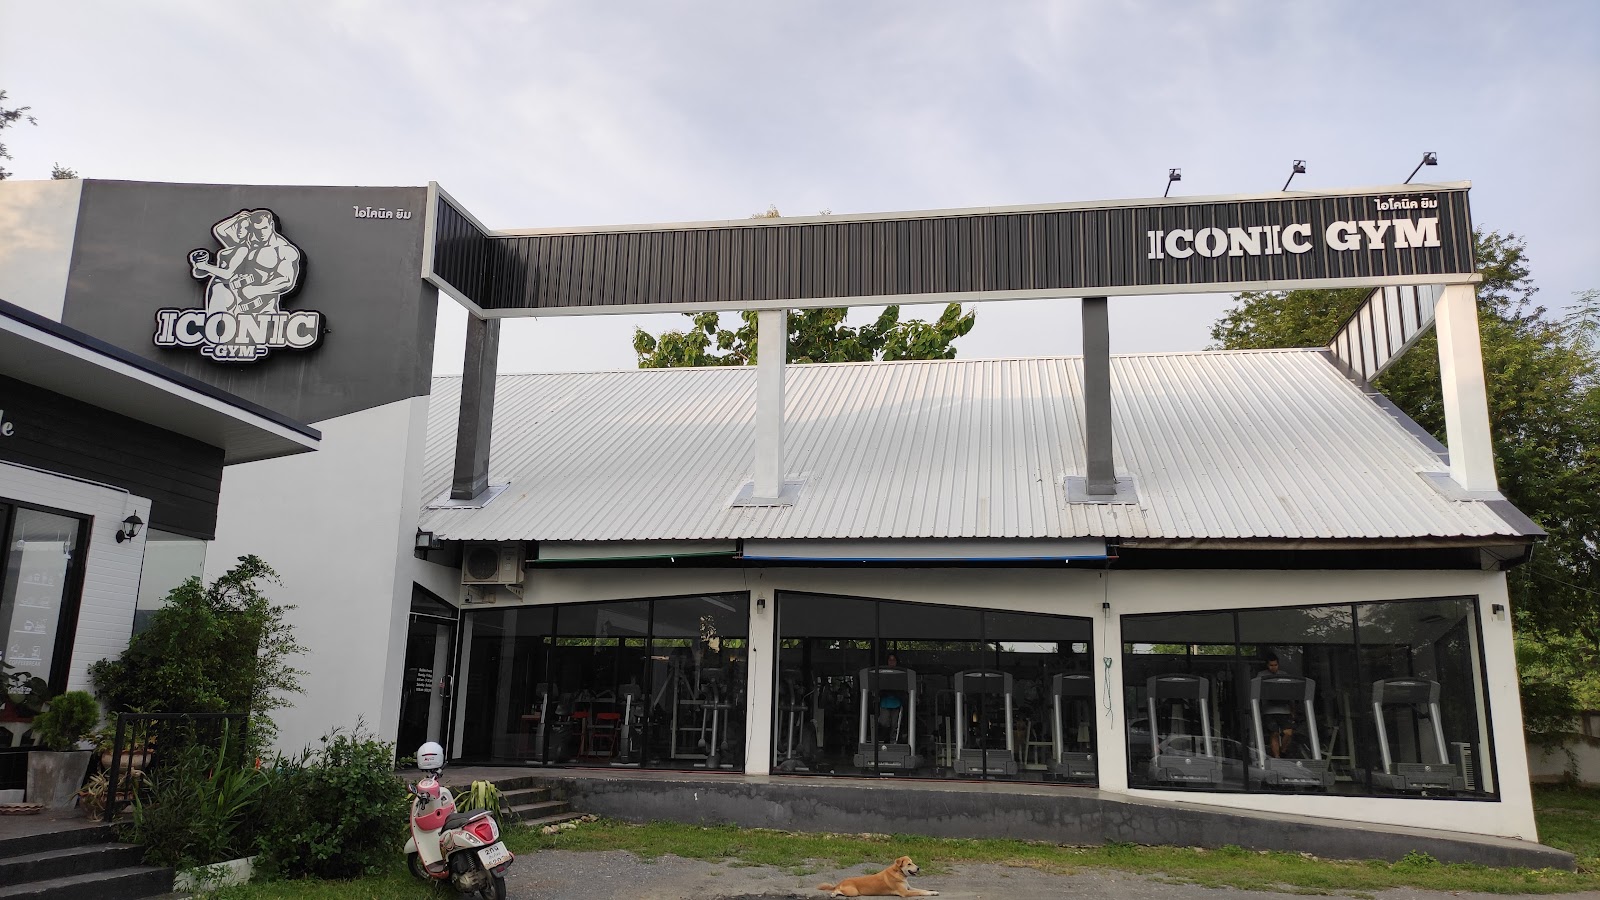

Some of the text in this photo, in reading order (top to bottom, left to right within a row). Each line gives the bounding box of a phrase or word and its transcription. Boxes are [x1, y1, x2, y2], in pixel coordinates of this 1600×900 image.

[1373, 197, 1438, 211] ไอโคนิค ยิม
[353, 205, 412, 220] ไอโคนิค ยิม
[1147, 217, 1441, 260] ICONIC GYM
[157, 311, 317, 347] ICONIC
[214, 345, 255, 358] GYM
